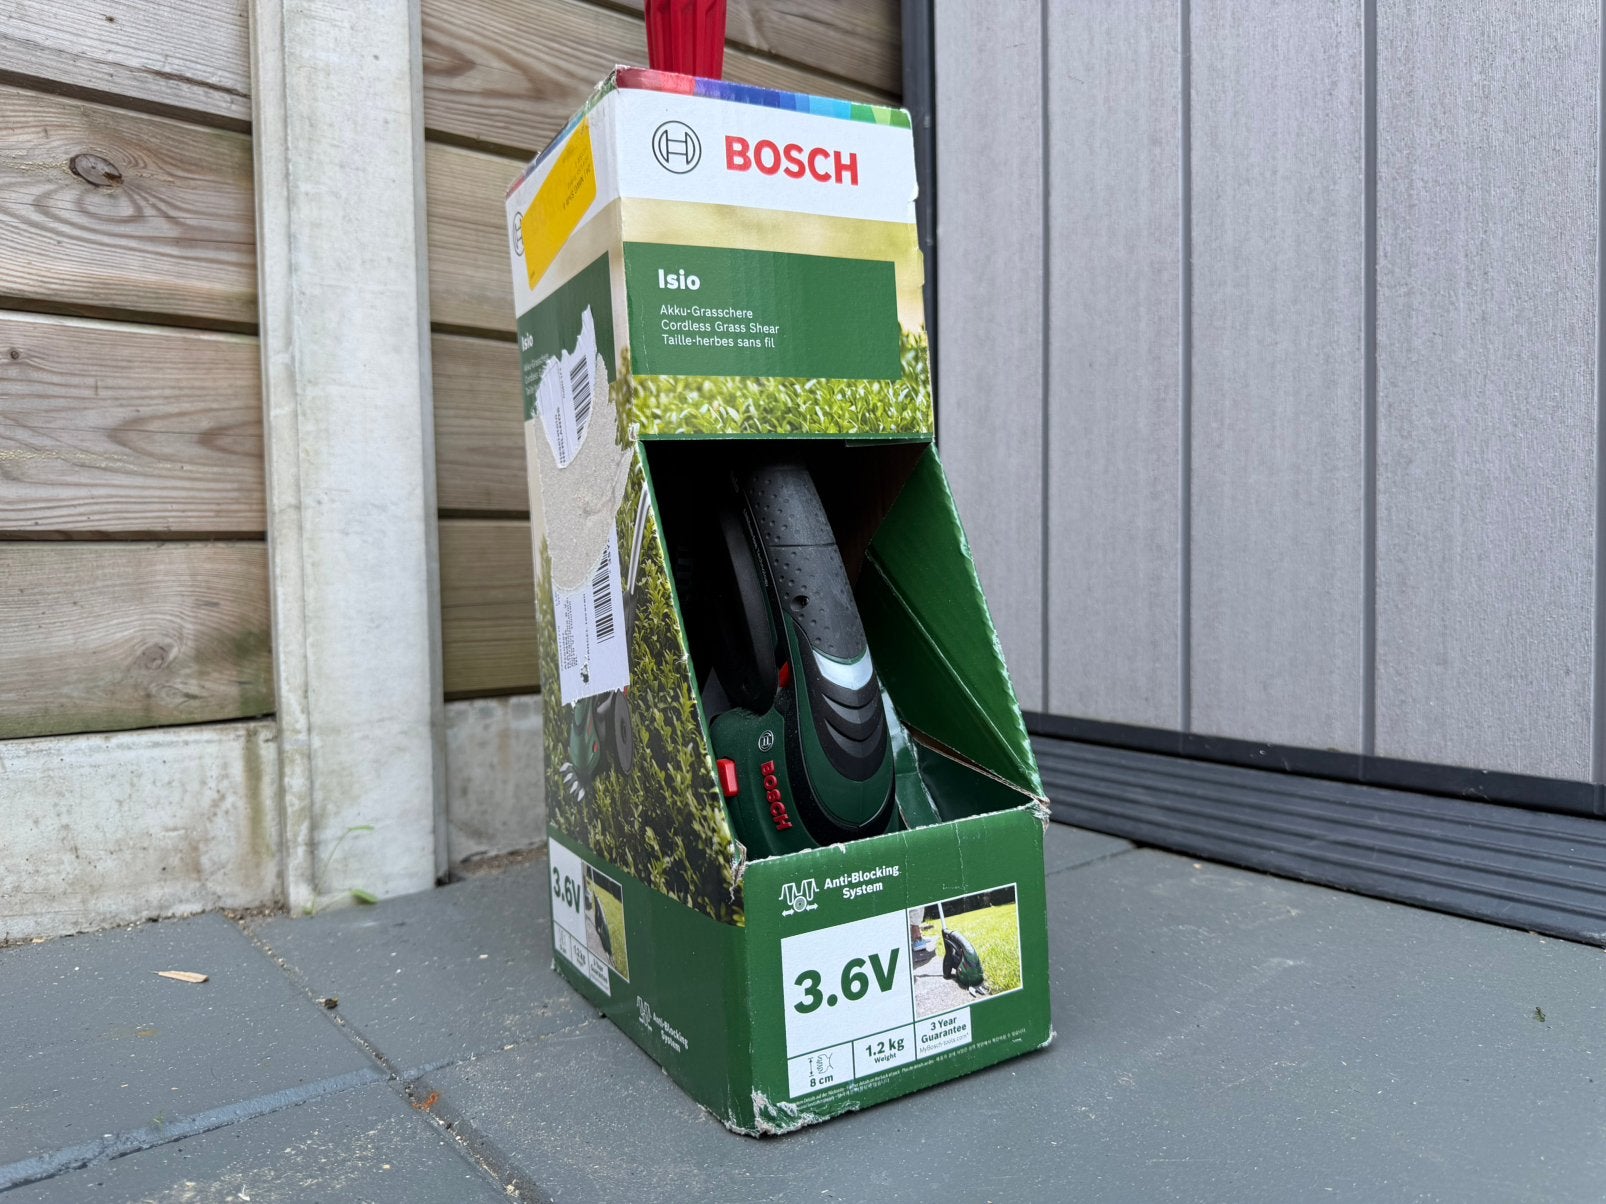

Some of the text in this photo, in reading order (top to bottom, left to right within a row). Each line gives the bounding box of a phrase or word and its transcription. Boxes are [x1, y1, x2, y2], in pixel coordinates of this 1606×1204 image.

[725, 135, 859, 186] BOSCH
[658, 269, 700, 290] Isio
[660, 304, 753, 318] Akku-Grasschere
[661, 319, 779, 334] Cordless Grass Shear
[521, 332, 533, 352] Isio
[662, 334, 775, 348] Taille-herbes sans fil
[761, 760, 793, 830] BOSCH
[824, 865, 900, 889] Anti-Blocking
[553, 866, 580, 914] 3.6V
[842, 882, 883, 900] System
[794, 947, 900, 1014] 3.6V
[921, 1024, 967, 1043] Guarantee
[930, 1017, 957, 1031] 3 Year
[865, 1038, 905, 1057] 1.2 kg
[874, 1052, 897, 1064] Weight
[810, 1078, 816, 1088] 8
[818, 1074, 834, 1085] cm
